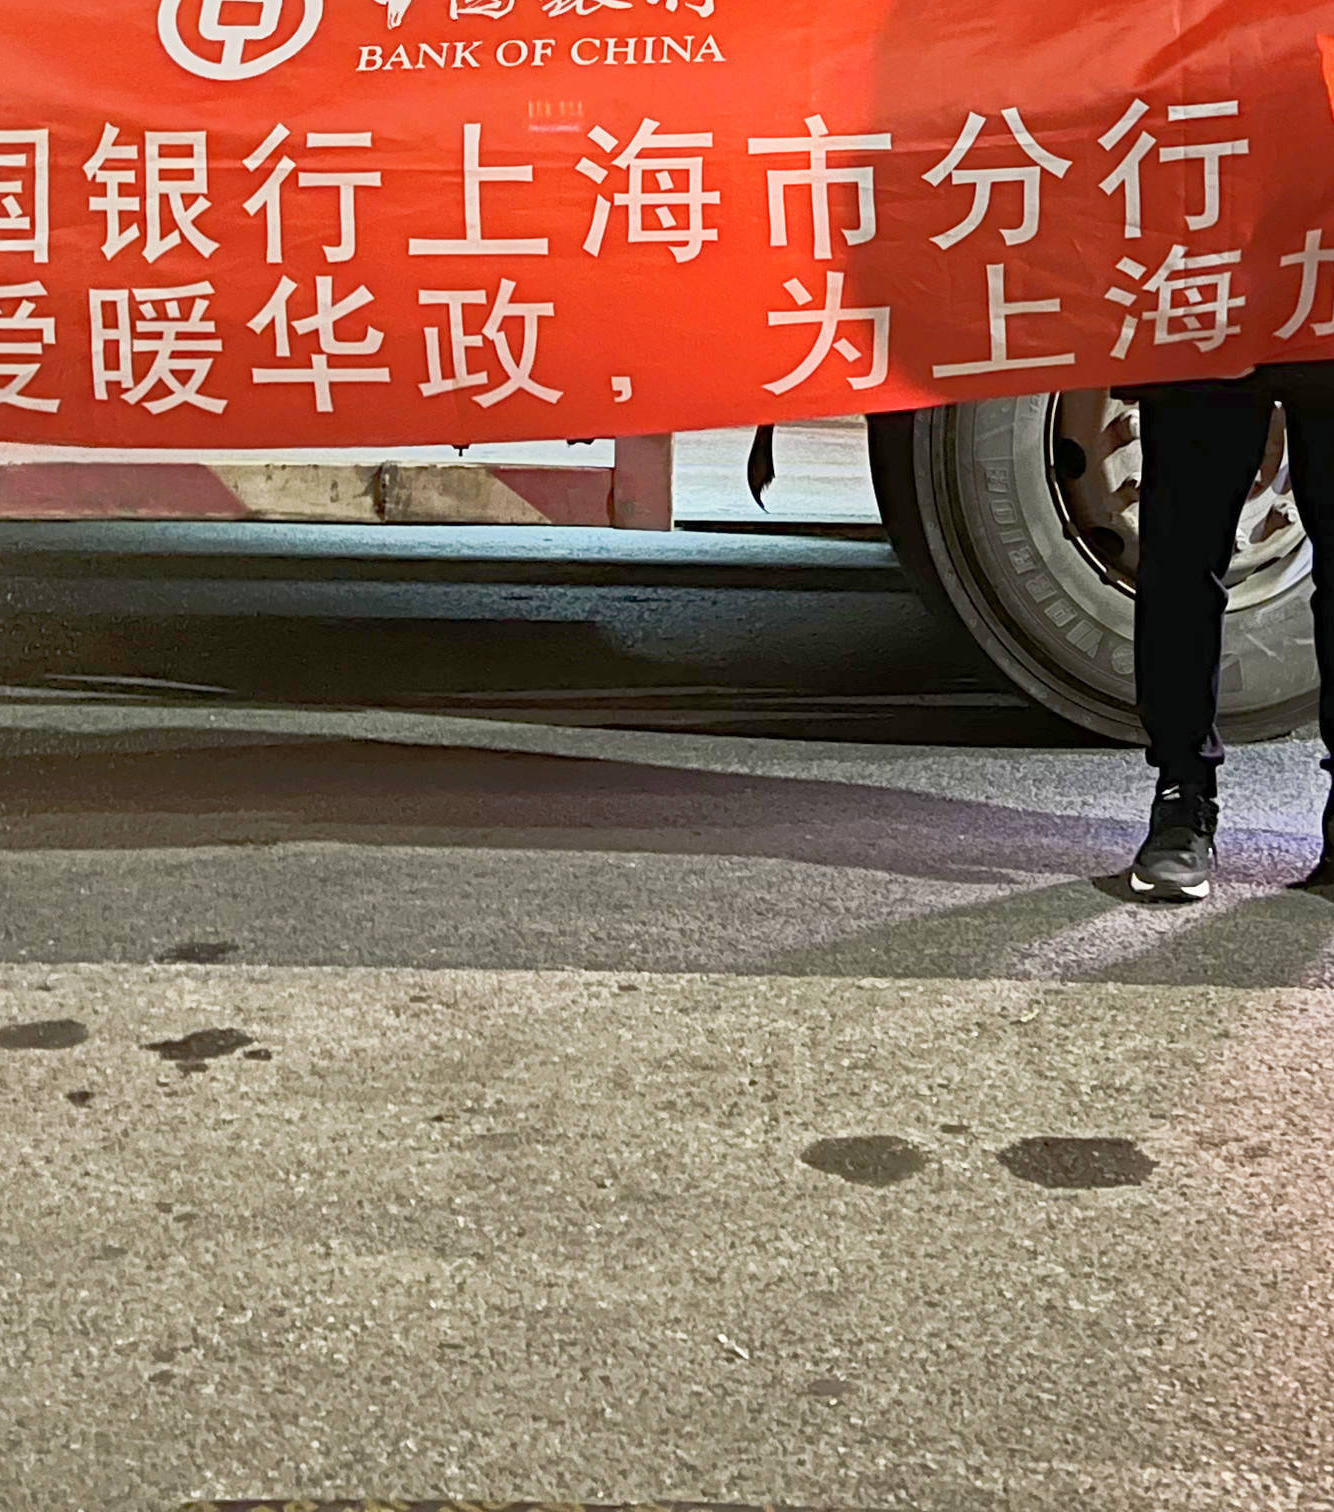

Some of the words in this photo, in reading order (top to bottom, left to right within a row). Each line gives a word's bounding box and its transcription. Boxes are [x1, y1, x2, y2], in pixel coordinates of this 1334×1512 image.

[356, 41, 480, 72] BANK
[496, 38, 555, 67] OF
[570, 35, 727, 66] CHINA
